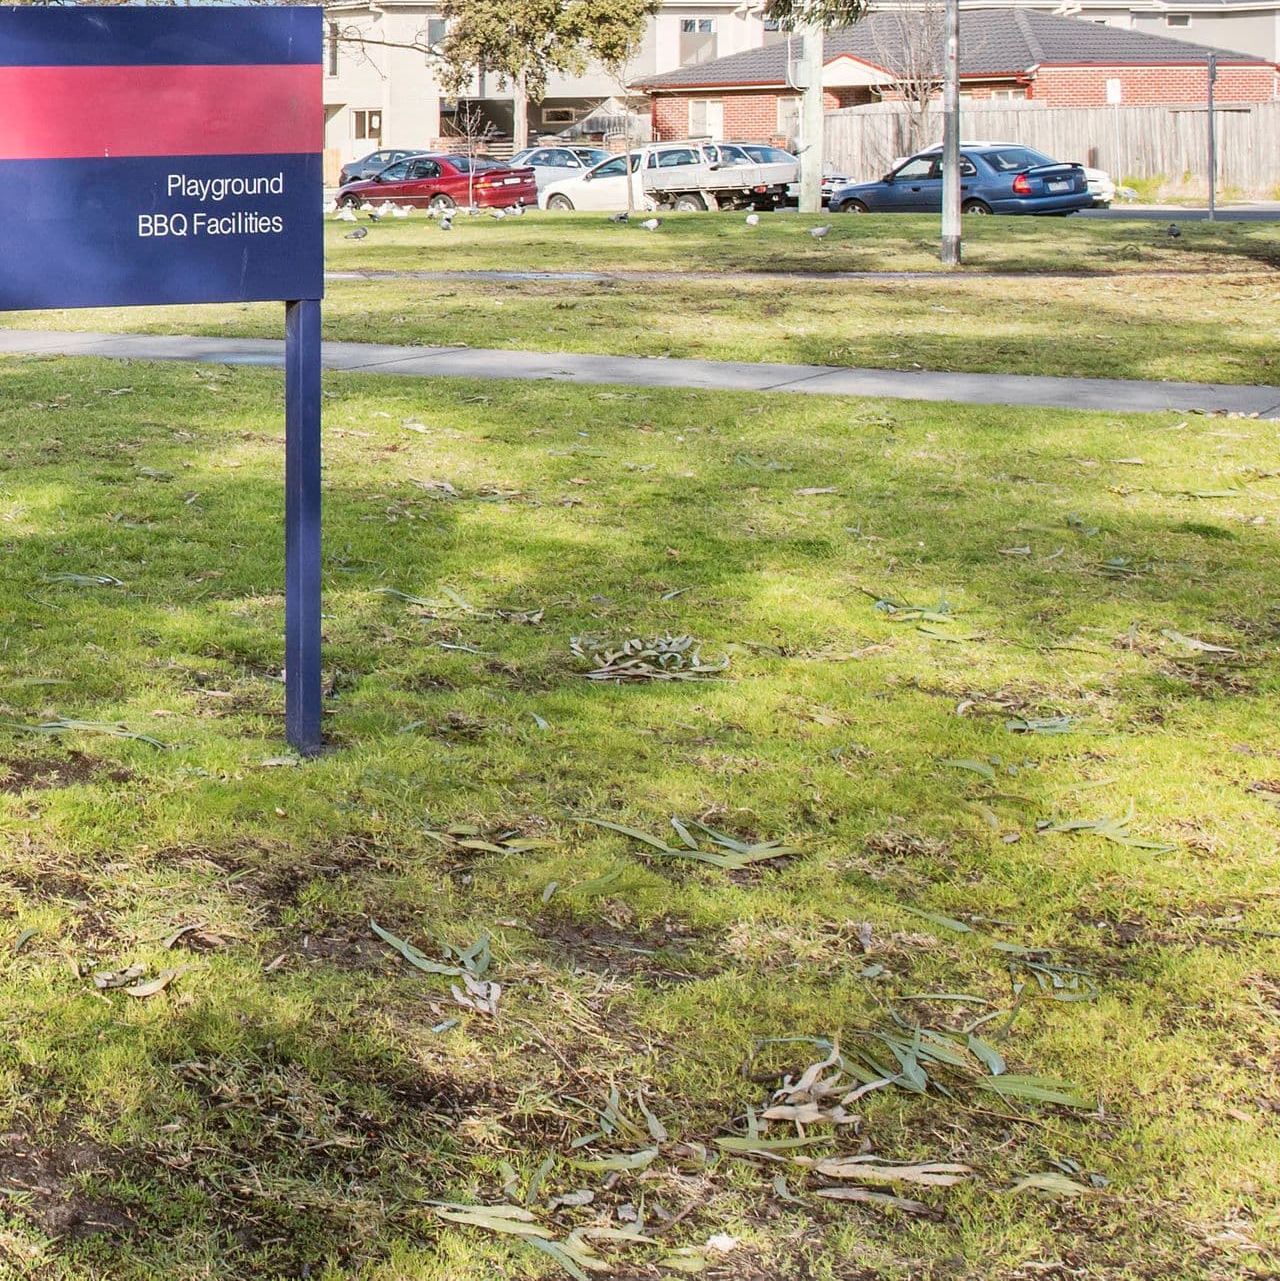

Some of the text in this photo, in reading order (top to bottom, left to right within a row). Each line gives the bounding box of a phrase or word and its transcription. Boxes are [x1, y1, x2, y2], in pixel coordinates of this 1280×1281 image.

[167, 172, 283, 202] Playground
[138, 211, 283, 237] BBQ Facilities
